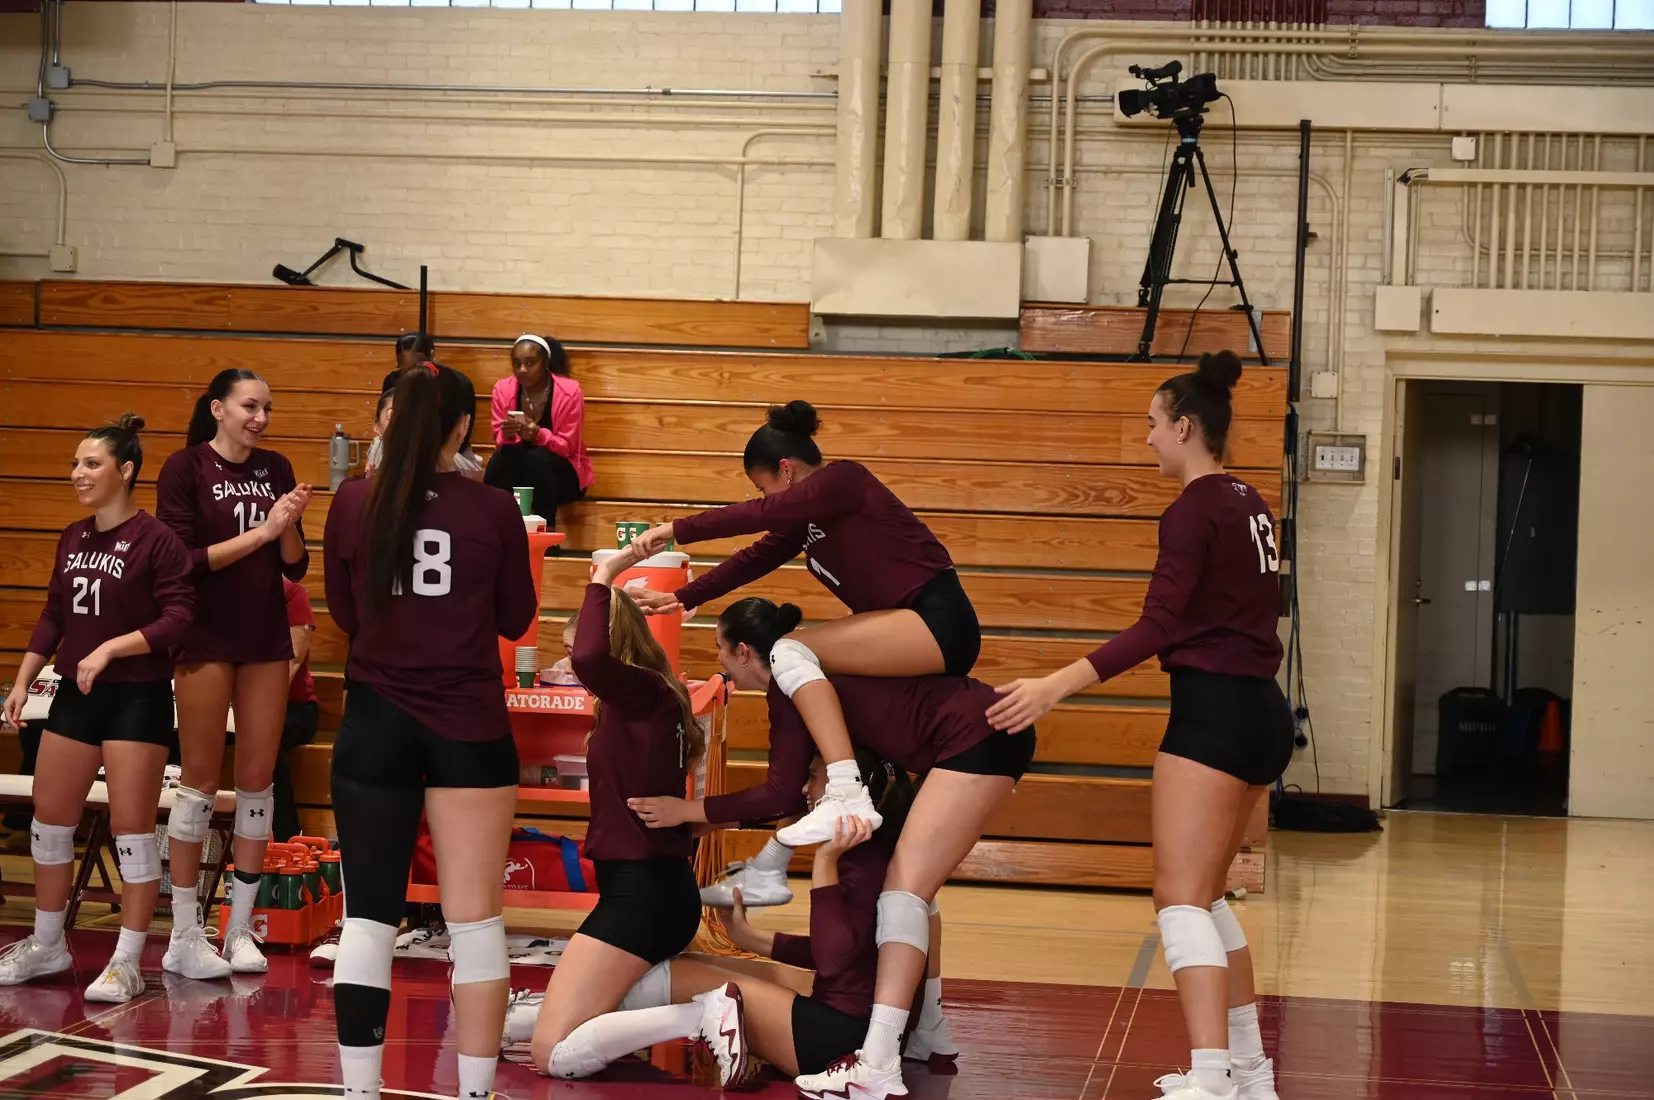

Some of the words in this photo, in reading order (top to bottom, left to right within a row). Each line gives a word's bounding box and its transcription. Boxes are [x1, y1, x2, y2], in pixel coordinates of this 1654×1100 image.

[212, 480, 276, 501] SALUKIS
[233, 501, 266, 536] 14
[616, 527, 626, 541] G
[1249, 513, 1280, 574] 13
[64, 551, 125, 579] SALUKIS
[72, 576, 102, 616] 21
[506, 693, 585, 710] ATORADE
[252, 914, 268, 938] G
